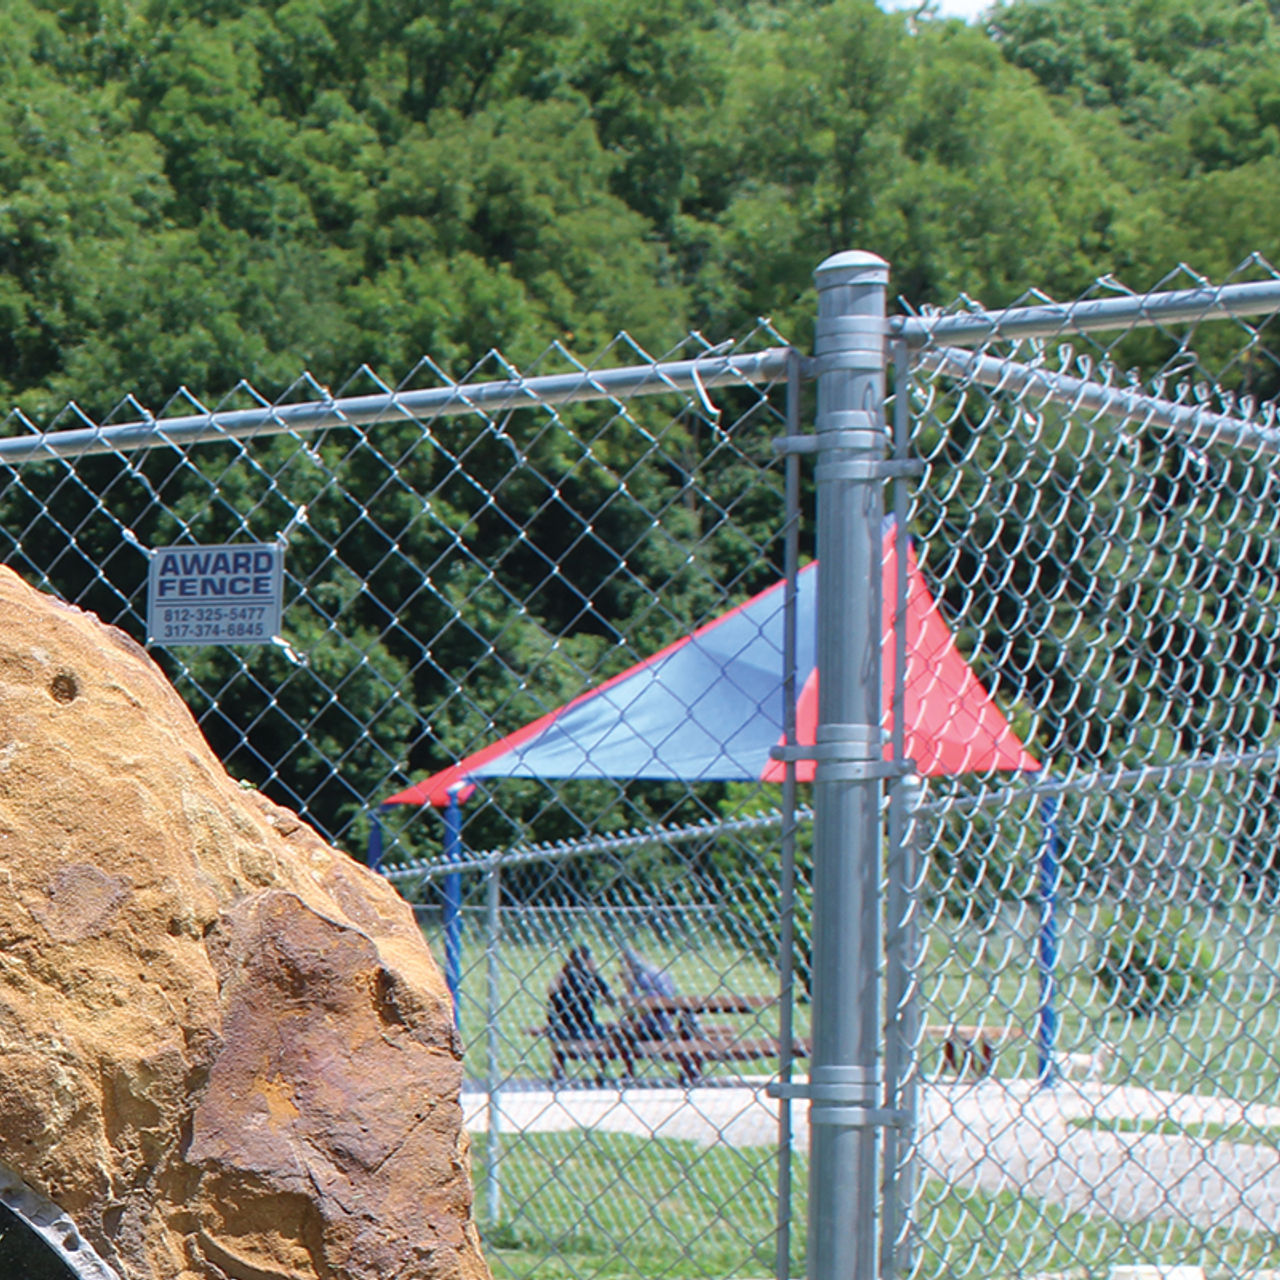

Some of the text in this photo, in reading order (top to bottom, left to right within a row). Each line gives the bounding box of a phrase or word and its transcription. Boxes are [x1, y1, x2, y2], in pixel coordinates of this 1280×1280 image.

[159, 551, 273, 576] AWARD
[158, 576, 272, 596] FENCE
[164, 607, 265, 622] 812-325-5477
